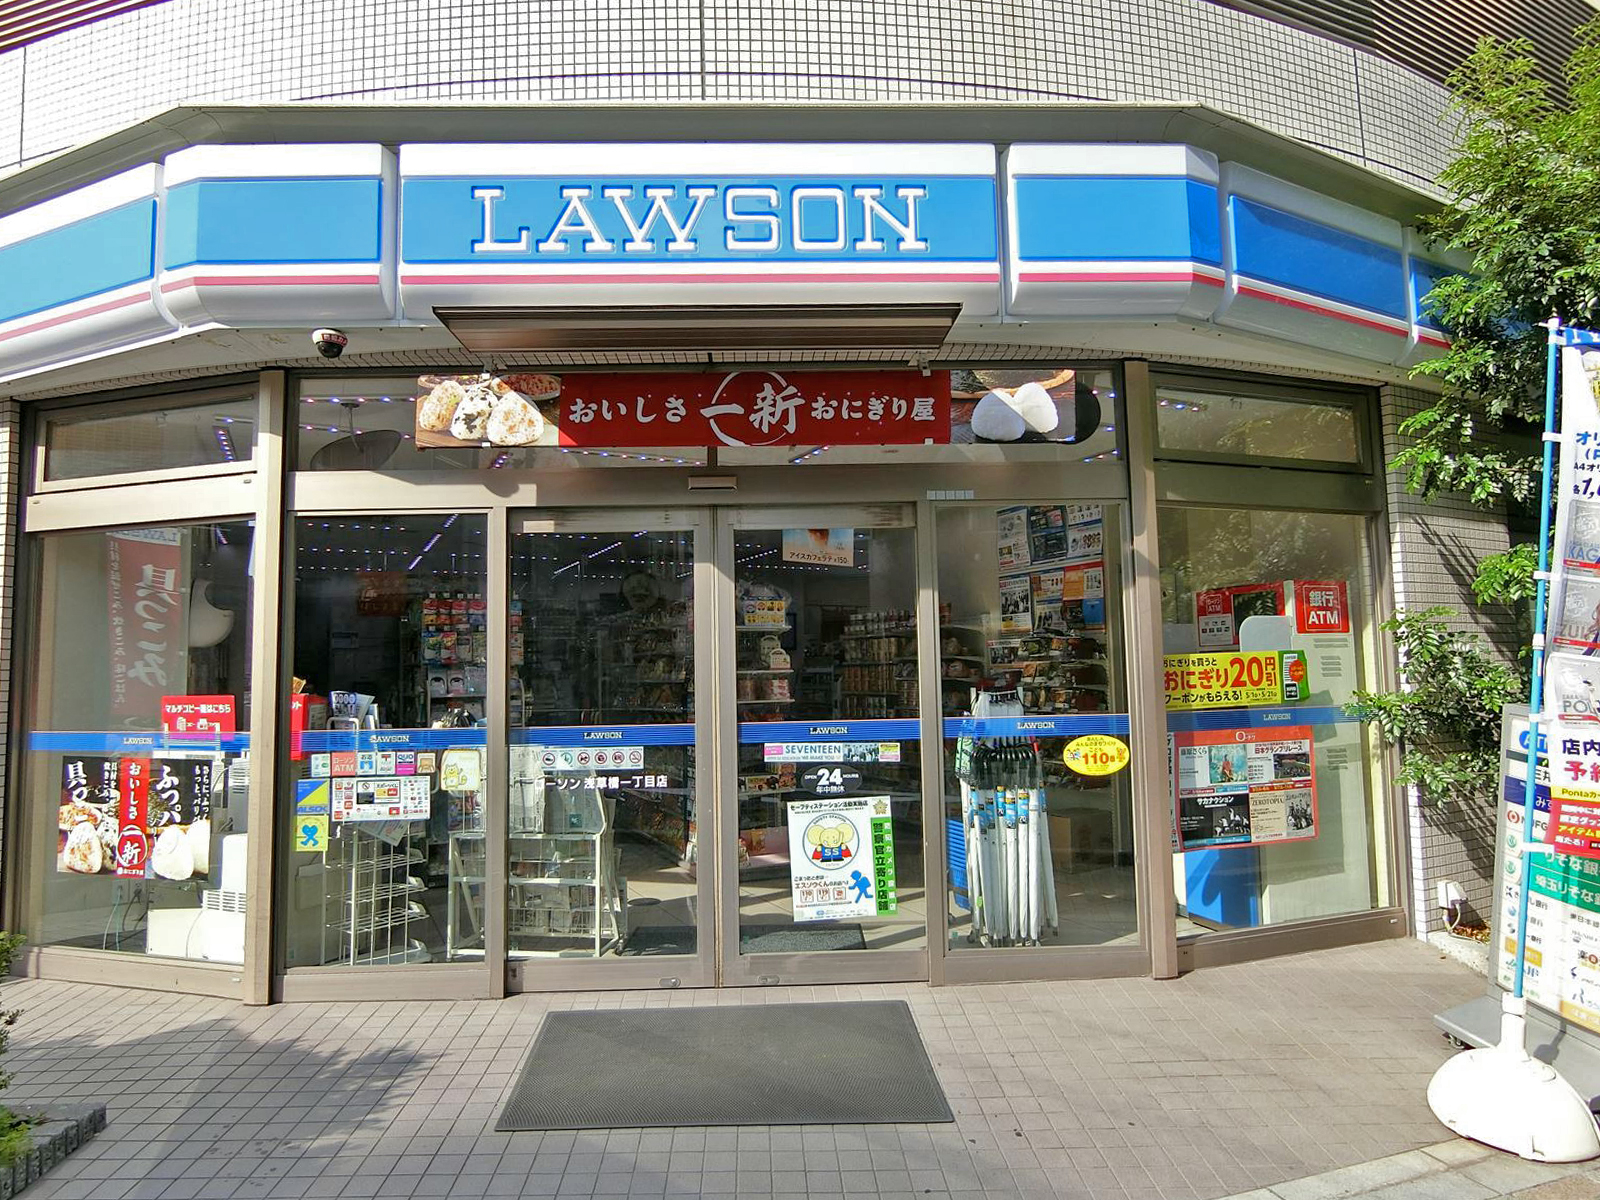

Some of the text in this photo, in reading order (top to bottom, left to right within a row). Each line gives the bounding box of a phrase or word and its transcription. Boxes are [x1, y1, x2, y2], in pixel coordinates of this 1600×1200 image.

[471, 186, 928, 254] LAWSON
[569, 382, 936, 435] おいしさ 一新 おにぎり屋
[1309, 590, 1335, 607] 銀行
[1207, 605, 1222, 613] ATM
[1308, 611, 1339, 625] ATM
[1263, 713, 1292, 721] LAWSON
[1017, 721, 1055, 730] LAWSON
[583, 731, 623, 740] LAWSON
[809, 727, 848, 735] LAWSON
[123, 737, 153, 745] LAWSON
[785, 744, 841, 754] SEVENTEEN
[1255, 744, 1303, 755] 日本グランプリレース
[397, 753, 414, 762] QUO
[334, 764, 355, 773] ATM
[816, 768, 843, 786] 24
[584, 774, 668, 790] 浅草橋一丁目店
[129, 762, 142, 820] おいしさ
[1196, 796, 1234, 805] サカナクション
[824, 848, 840, 856] SS
